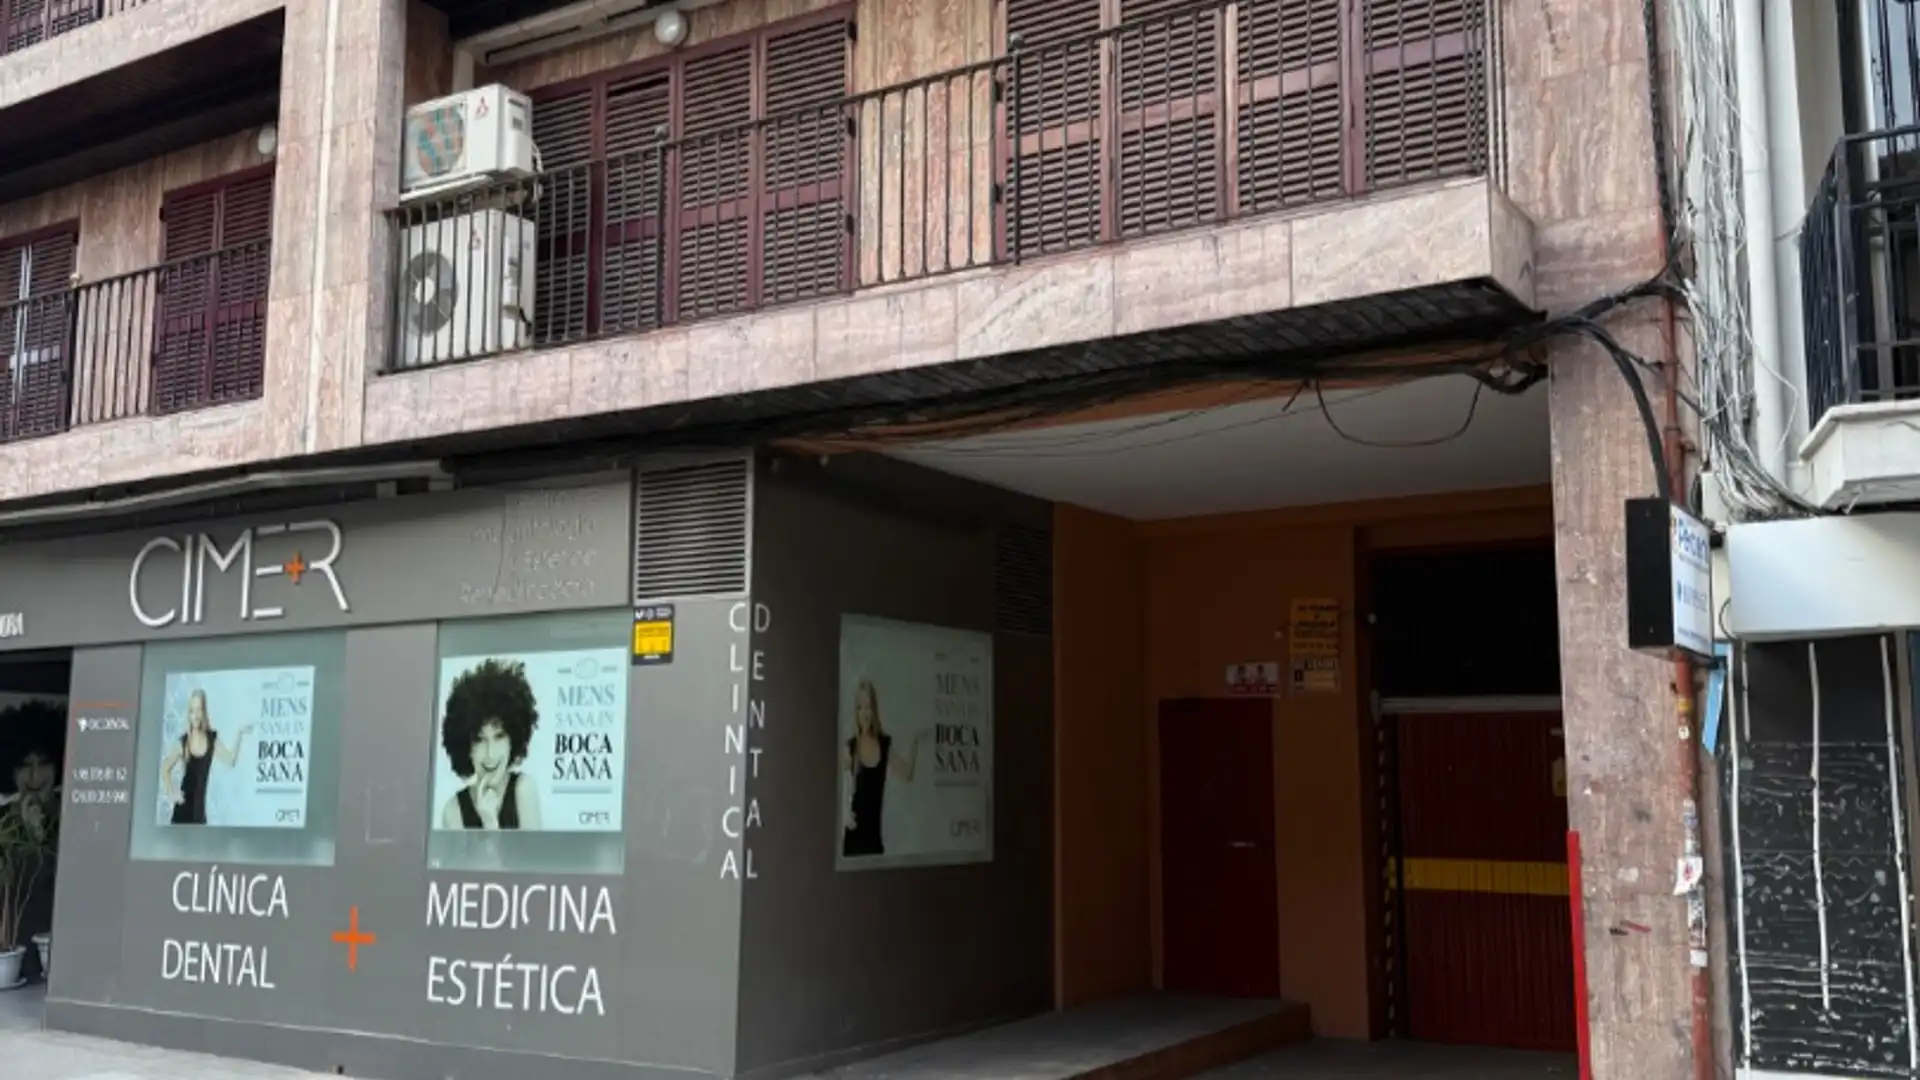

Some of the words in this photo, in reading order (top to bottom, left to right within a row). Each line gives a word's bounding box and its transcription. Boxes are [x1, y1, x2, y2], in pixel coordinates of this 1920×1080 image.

[130, 519, 350, 627] CIMER
[260, 697, 308, 717] MENS
[556, 684, 615, 707] MENS
[555, 732, 613, 754] BOCA
[935, 722, 980, 746] BOCA
[258, 740, 305, 760] BOCA
[935, 749, 980, 774] SANA
[256, 761, 303, 782] SANA
[552, 756, 613, 780] SANA
[172, 864, 289, 918] CLÍNICA
[426, 881, 617, 935] MEDICINA
[161, 938, 275, 989] DENTAL
[427, 953, 605, 1016] ESTÉTICA
